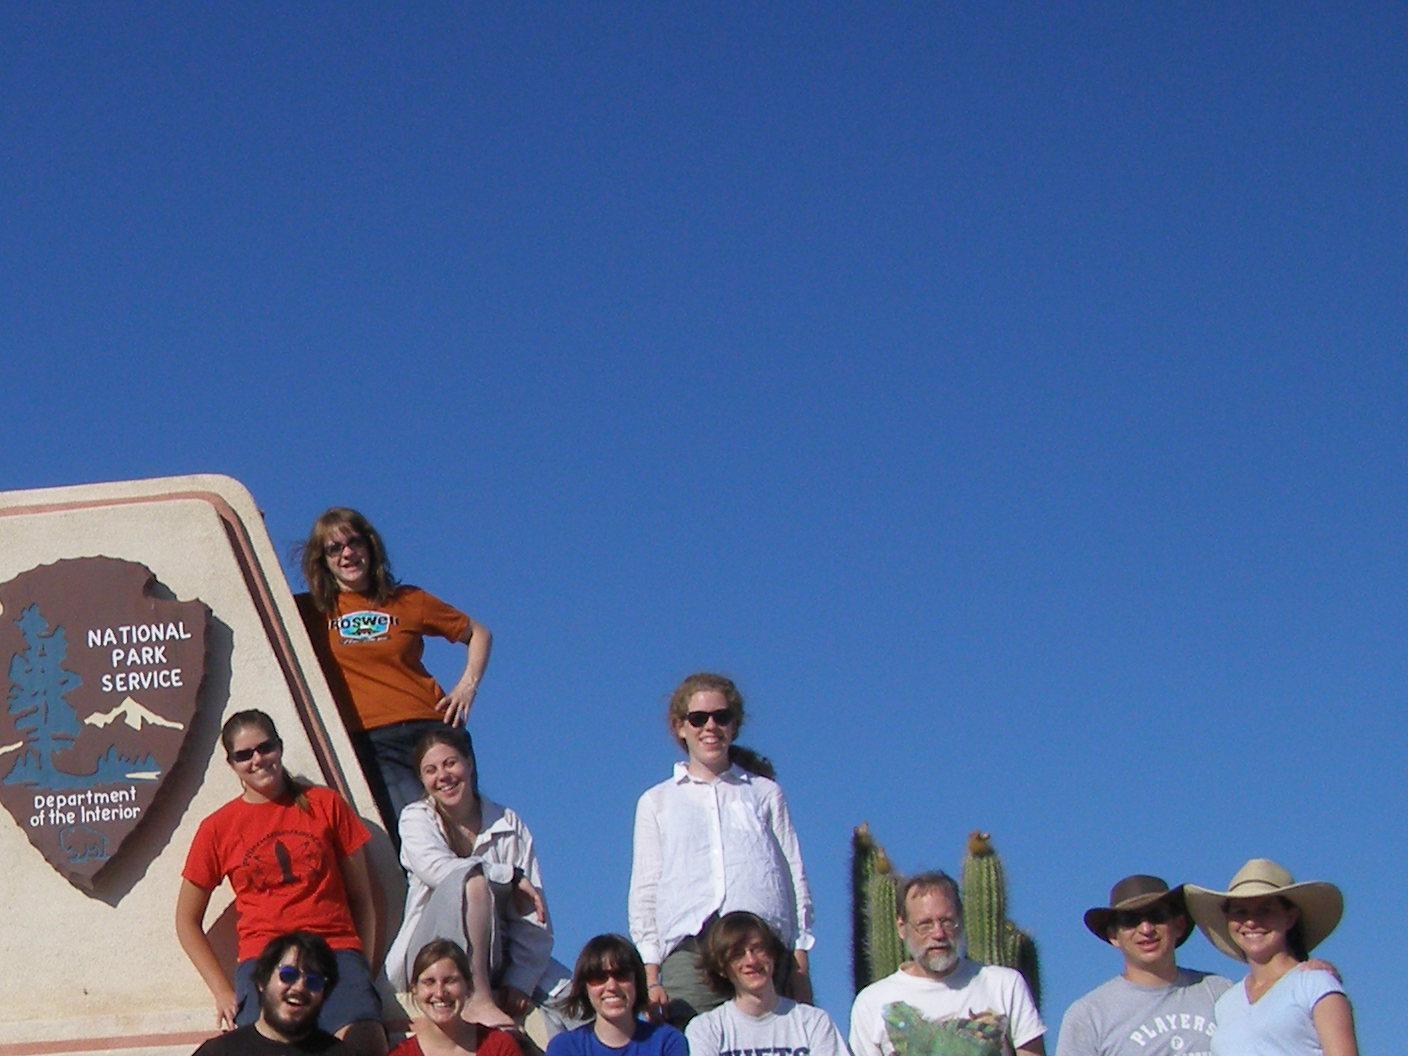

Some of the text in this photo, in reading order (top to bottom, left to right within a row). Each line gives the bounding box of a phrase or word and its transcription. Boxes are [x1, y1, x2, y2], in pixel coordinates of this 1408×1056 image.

[87, 621, 192, 649] NATIONAL
[112, 645, 168, 668] PARK
[101, 668, 184, 692] SERVICE
[34, 785, 137, 810] Department
[30, 804, 141, 827] of the Interior
[1130, 1013, 1217, 1047] PLAYERS
